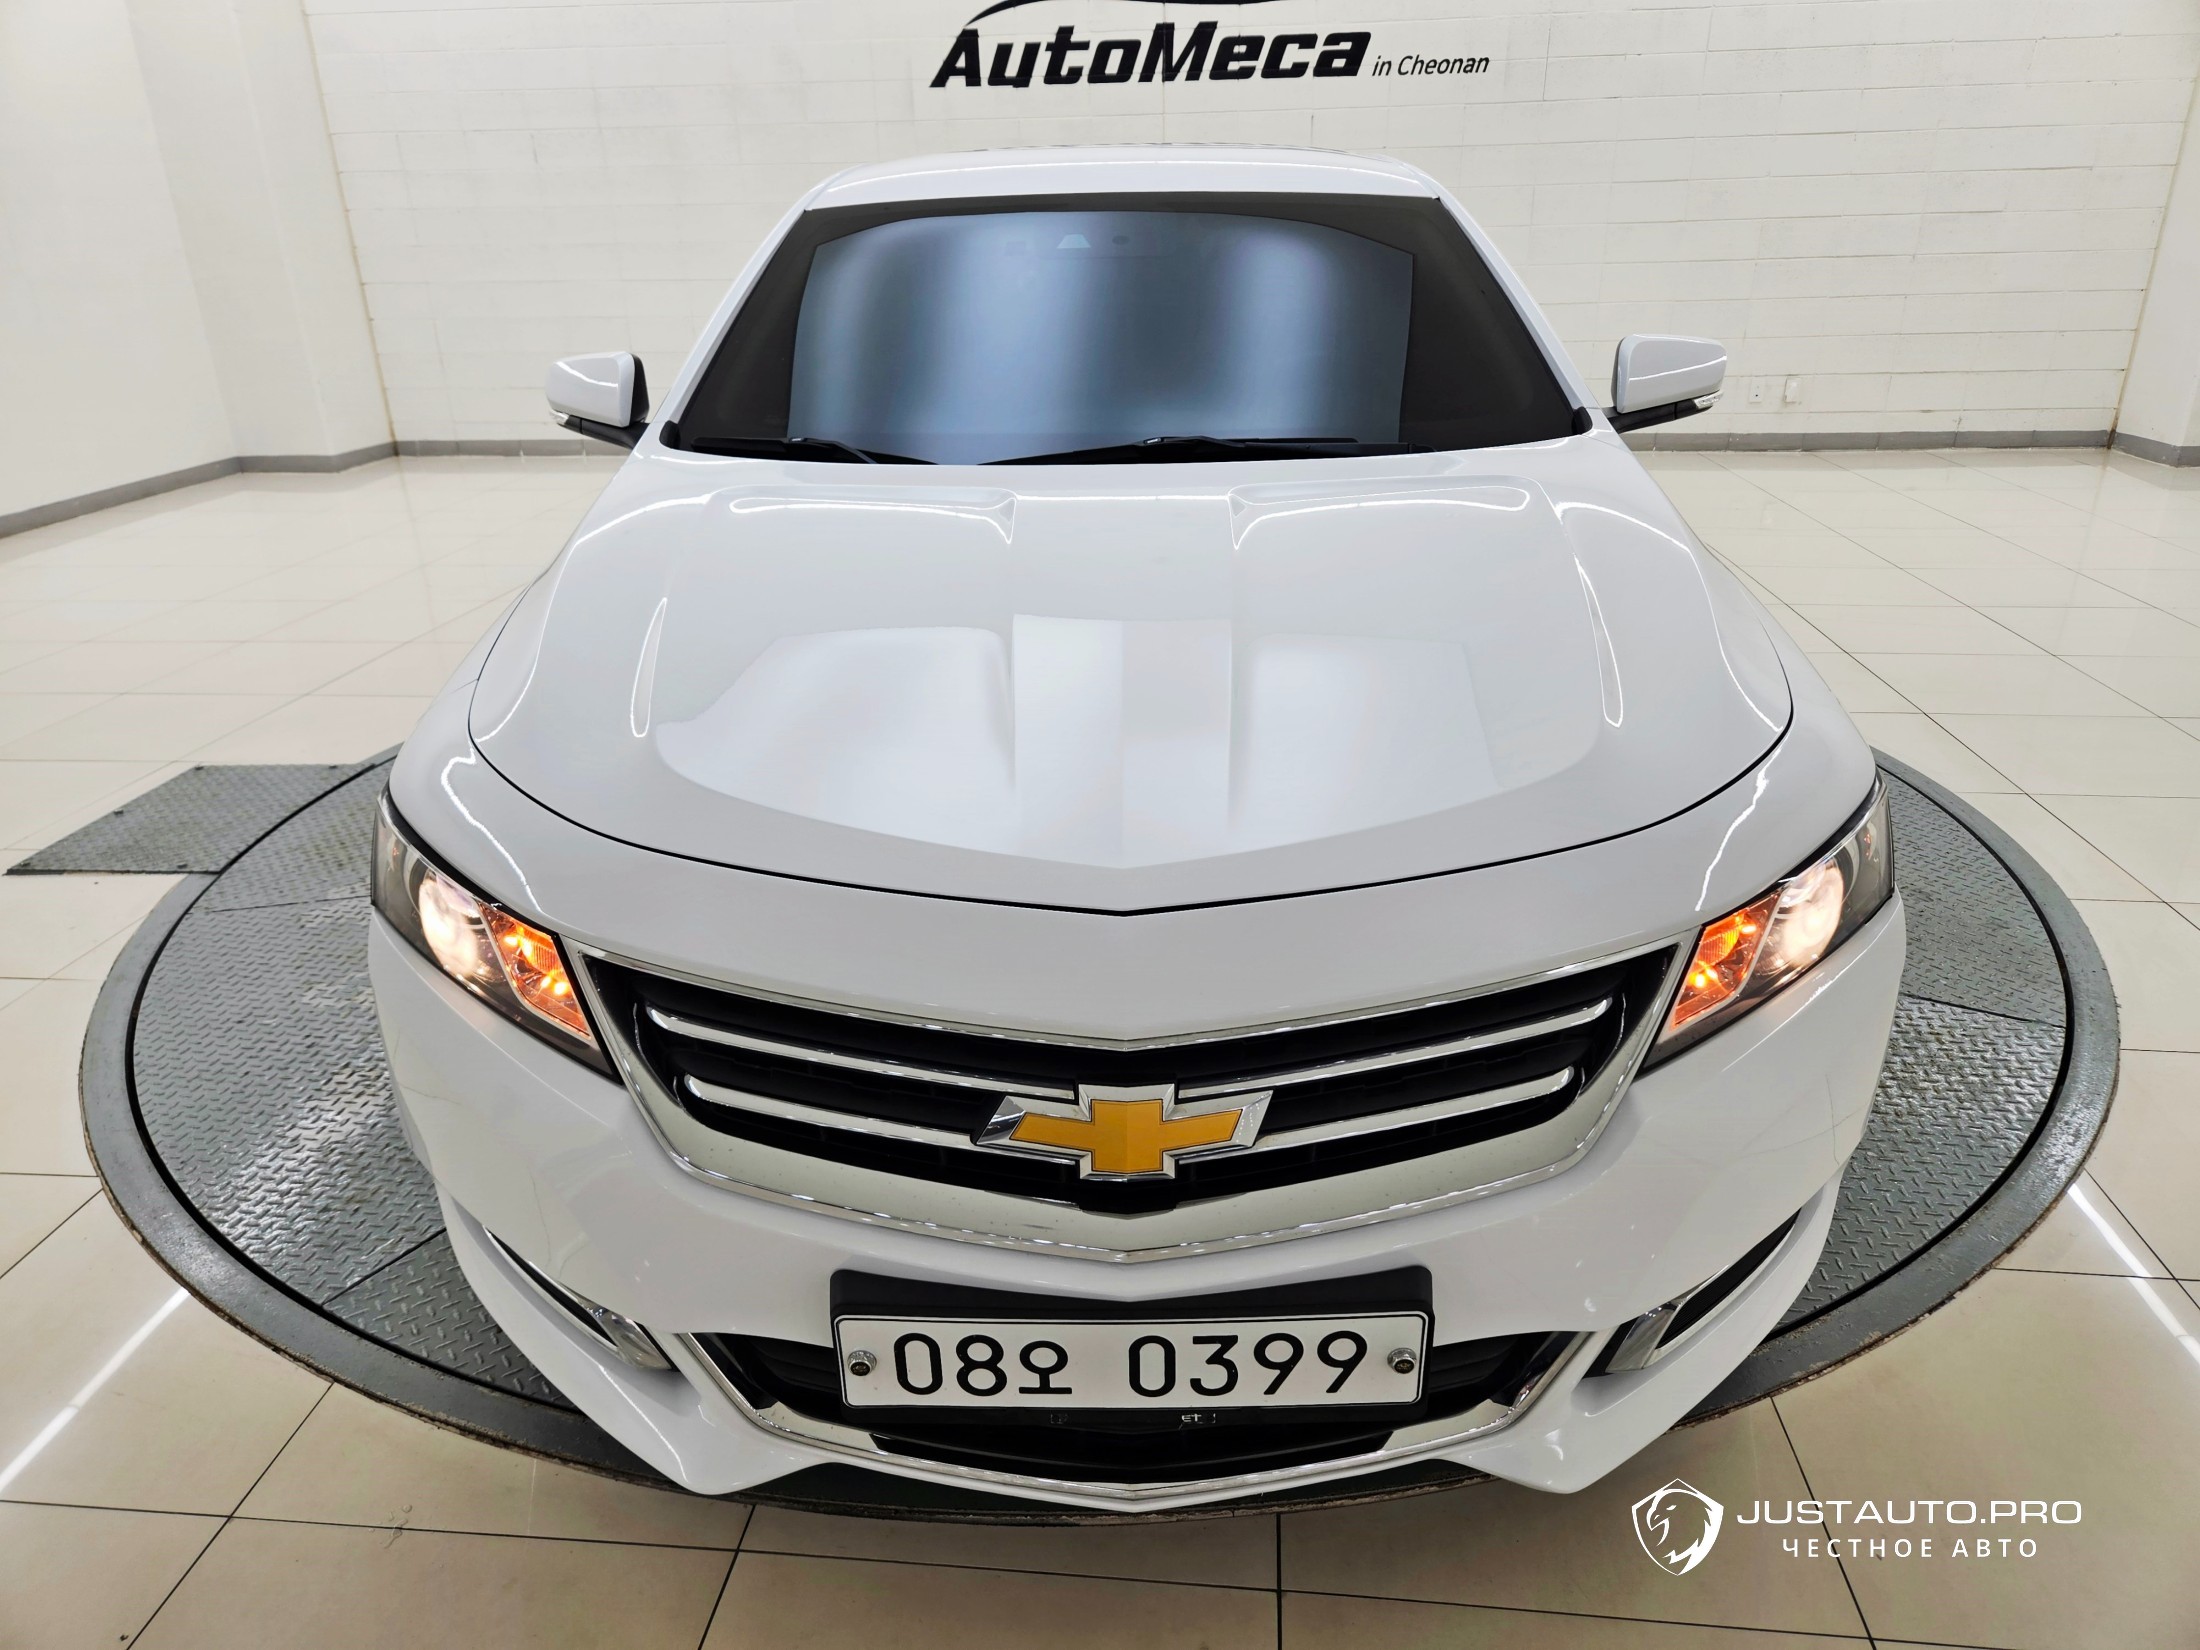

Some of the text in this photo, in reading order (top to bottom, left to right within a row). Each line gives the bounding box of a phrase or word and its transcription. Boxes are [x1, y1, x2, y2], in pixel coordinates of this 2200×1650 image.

[930, 22, 1490, 88] AutoMeca in Cheonan
[893, 1330, 1368, 1398] 08오 0399
